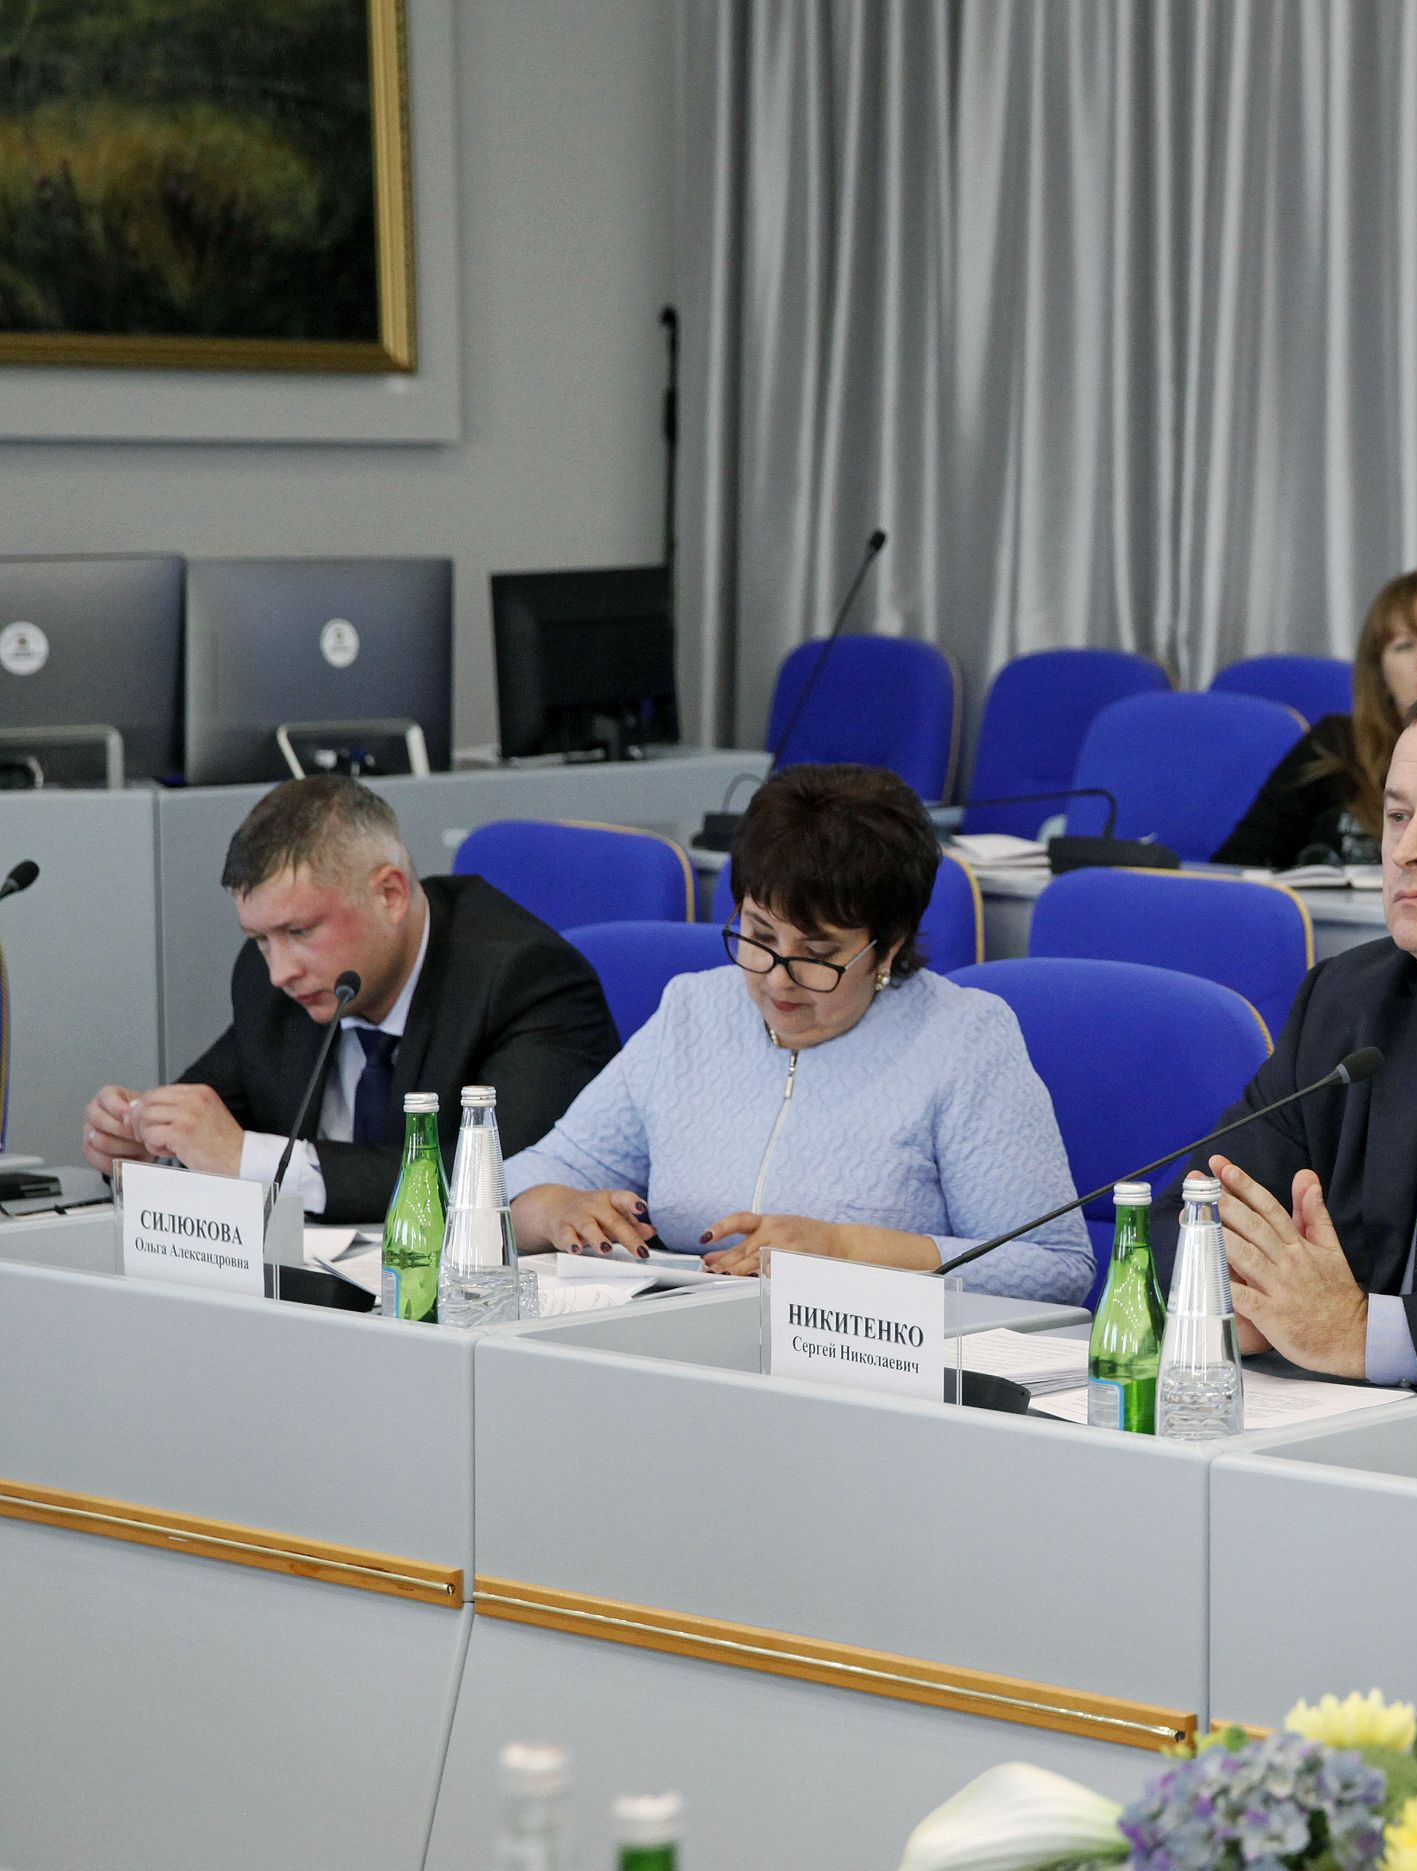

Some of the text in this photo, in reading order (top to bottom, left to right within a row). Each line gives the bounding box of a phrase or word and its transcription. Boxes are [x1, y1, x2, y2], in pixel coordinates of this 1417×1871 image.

[140, 1209, 243, 1246] СИЛЮКОВА
[135, 1237, 249, 1270] Ольга Александровна
[788, 1303, 924, 1348] НИКИТЕНКО
[792, 1335, 919, 1374] Сергей Николаевич
